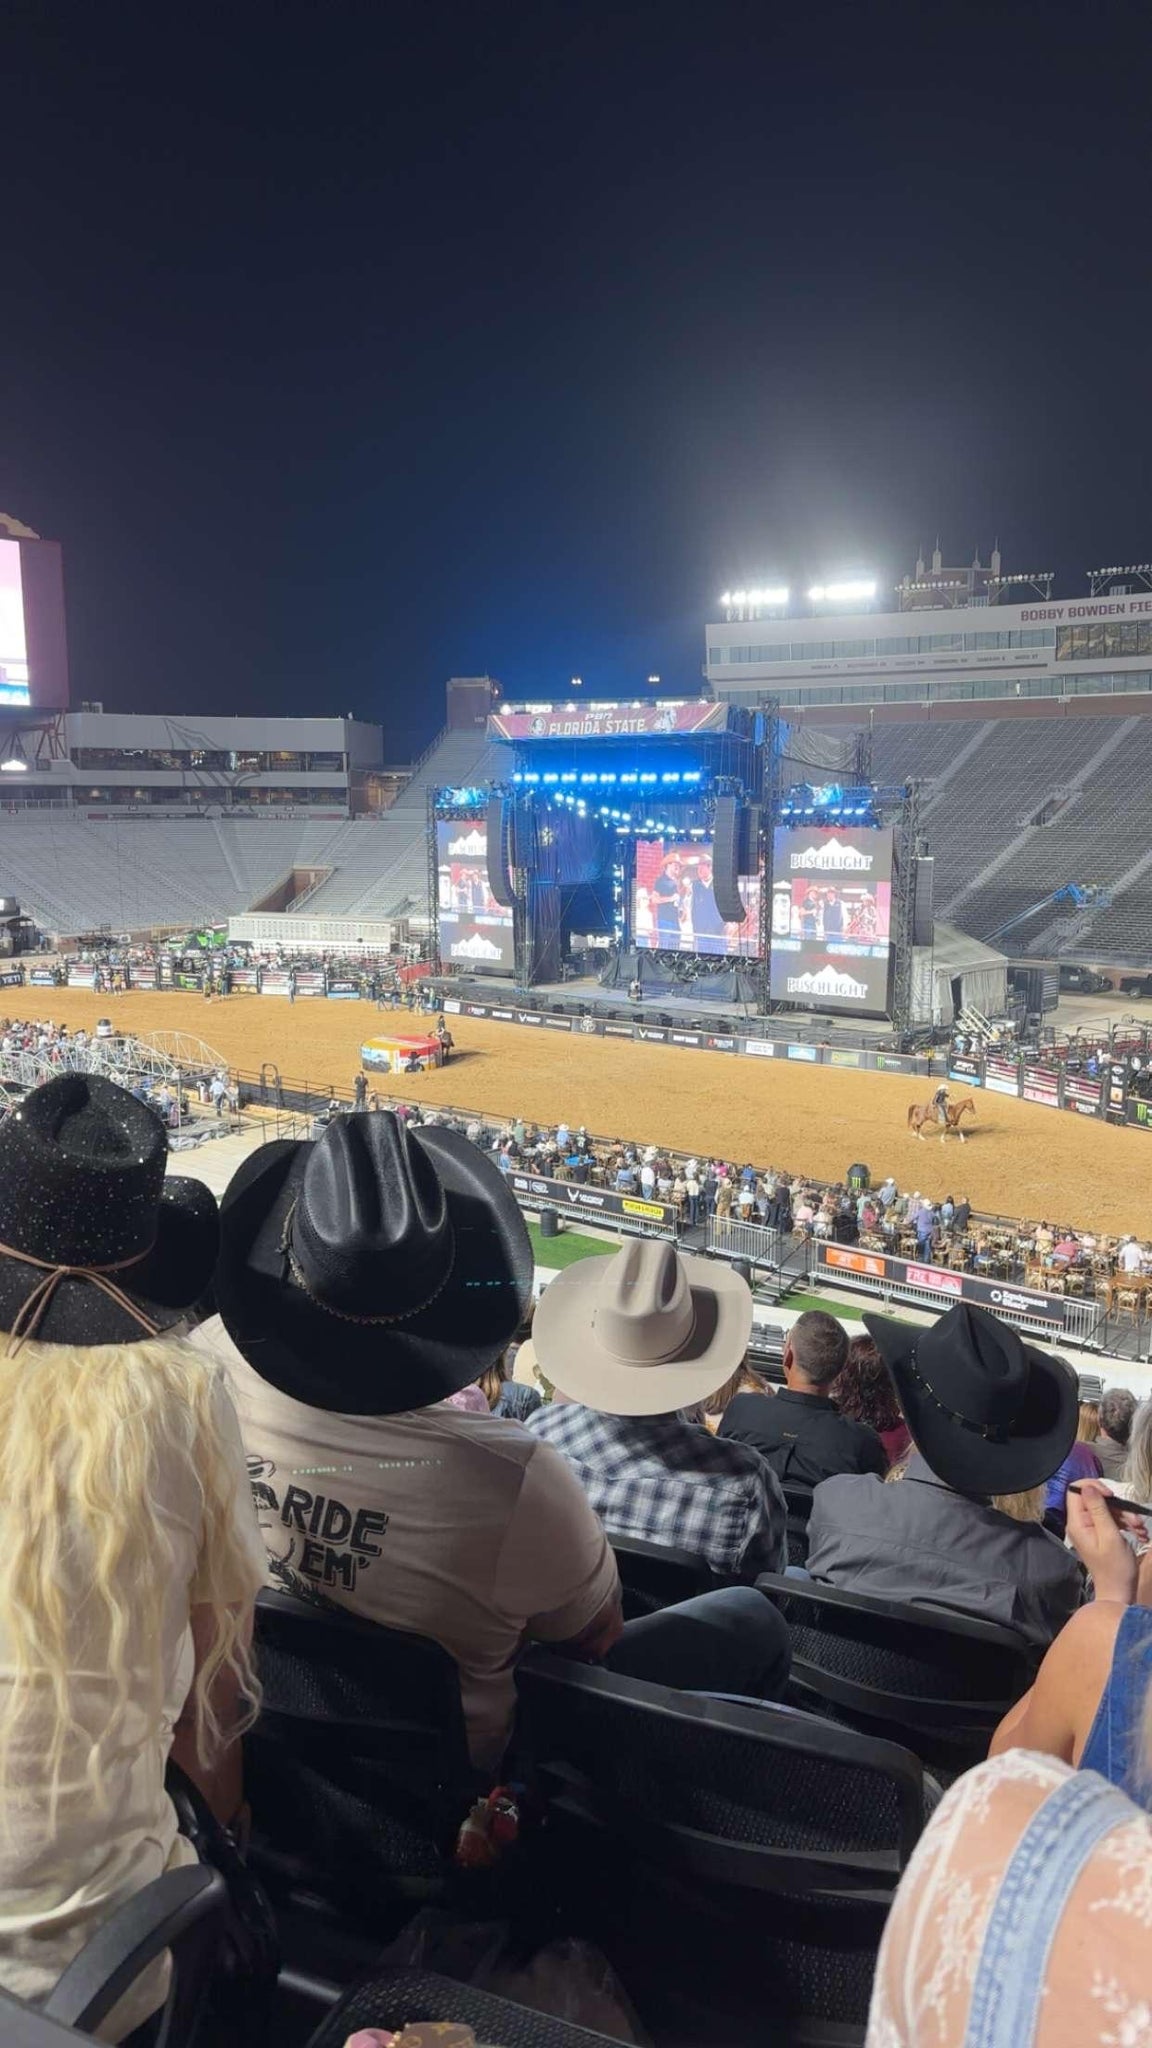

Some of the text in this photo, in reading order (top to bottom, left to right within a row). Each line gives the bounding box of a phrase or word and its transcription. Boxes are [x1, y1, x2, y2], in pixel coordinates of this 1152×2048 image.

[1020, 609, 1064, 621] BOBBY
[1068, 603, 1125, 618] BOWDEN
[548, 719, 645, 735] FLORIDA STATE
[281, 1484, 389, 1556] RIDE
